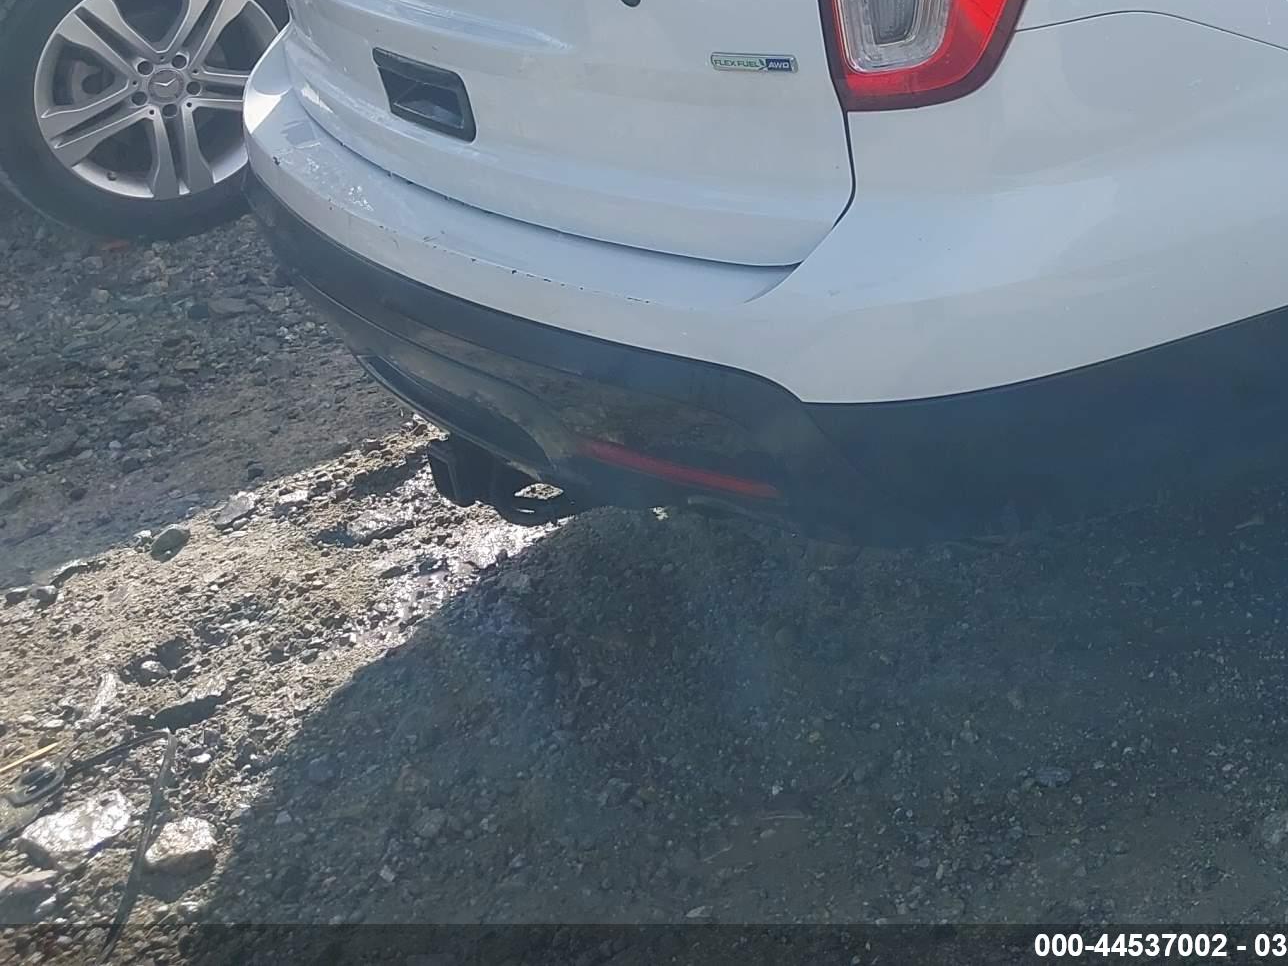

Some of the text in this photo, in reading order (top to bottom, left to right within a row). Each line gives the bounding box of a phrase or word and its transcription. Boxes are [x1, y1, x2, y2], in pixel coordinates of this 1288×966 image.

[714, 59, 790, 69] FLEX FUEL AWD
